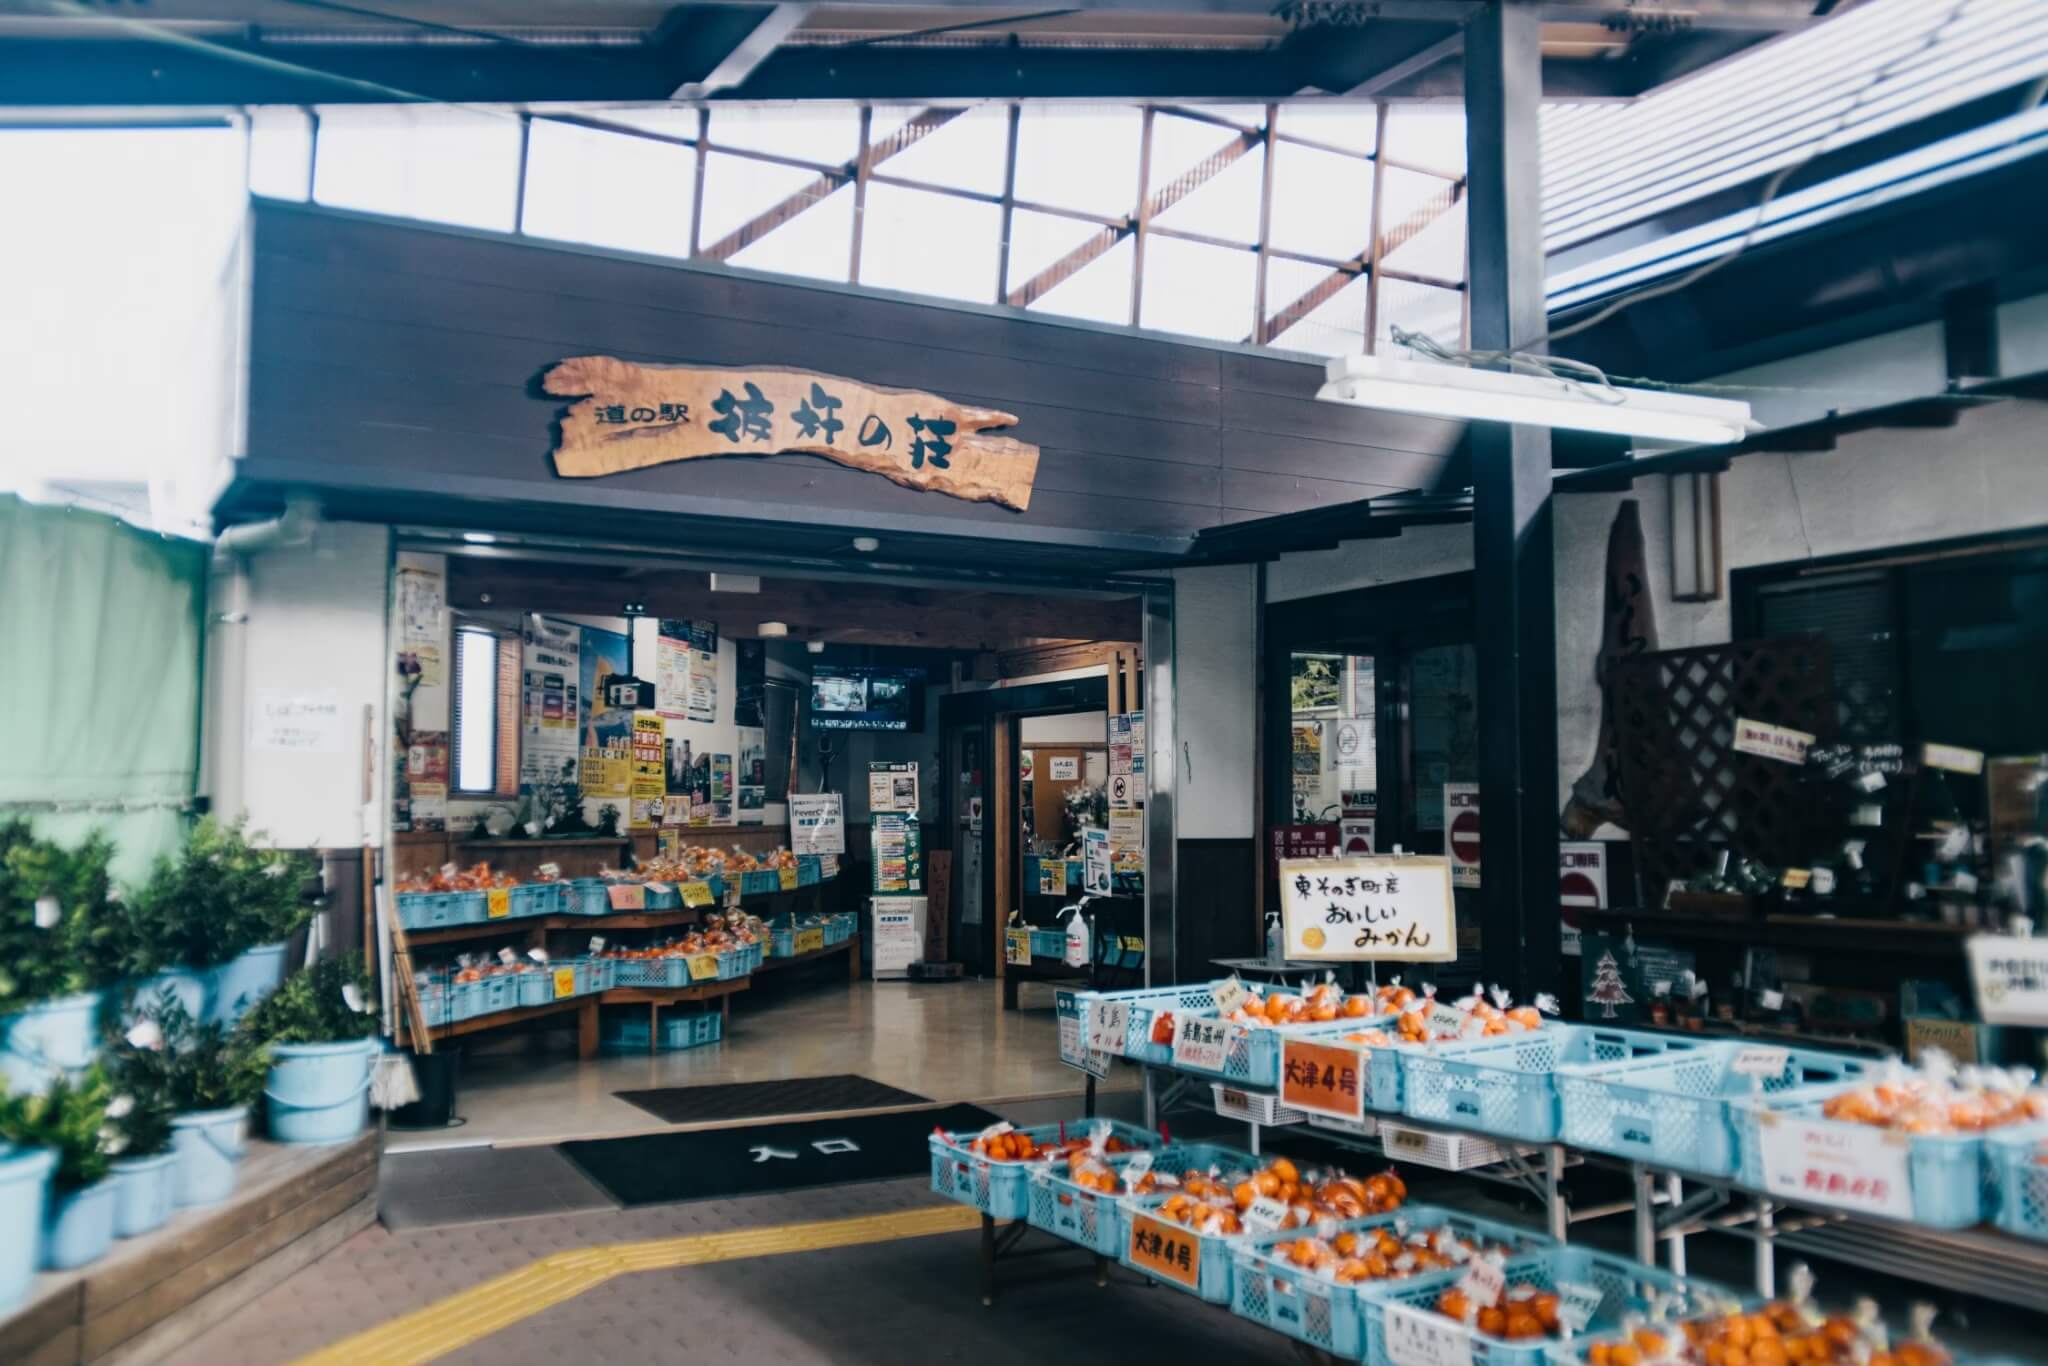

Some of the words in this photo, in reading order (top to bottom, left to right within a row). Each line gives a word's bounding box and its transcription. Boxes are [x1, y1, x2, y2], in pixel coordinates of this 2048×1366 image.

[594, 402, 690, 426] 道の駅
[707, 381, 958, 471] 彼杵の荘
[1352, 793, 1376, 805] AED
[1295, 873, 1400, 899] 東そのぎ町産
[1325, 903, 1397, 924] おいしい
[1354, 923, 1431, 948] みかん
[1283, 1057, 1359, 1097] 大津4号
[748, 1138, 860, 1163] 入口
[1135, 1229, 1193, 1273] 大津4号
